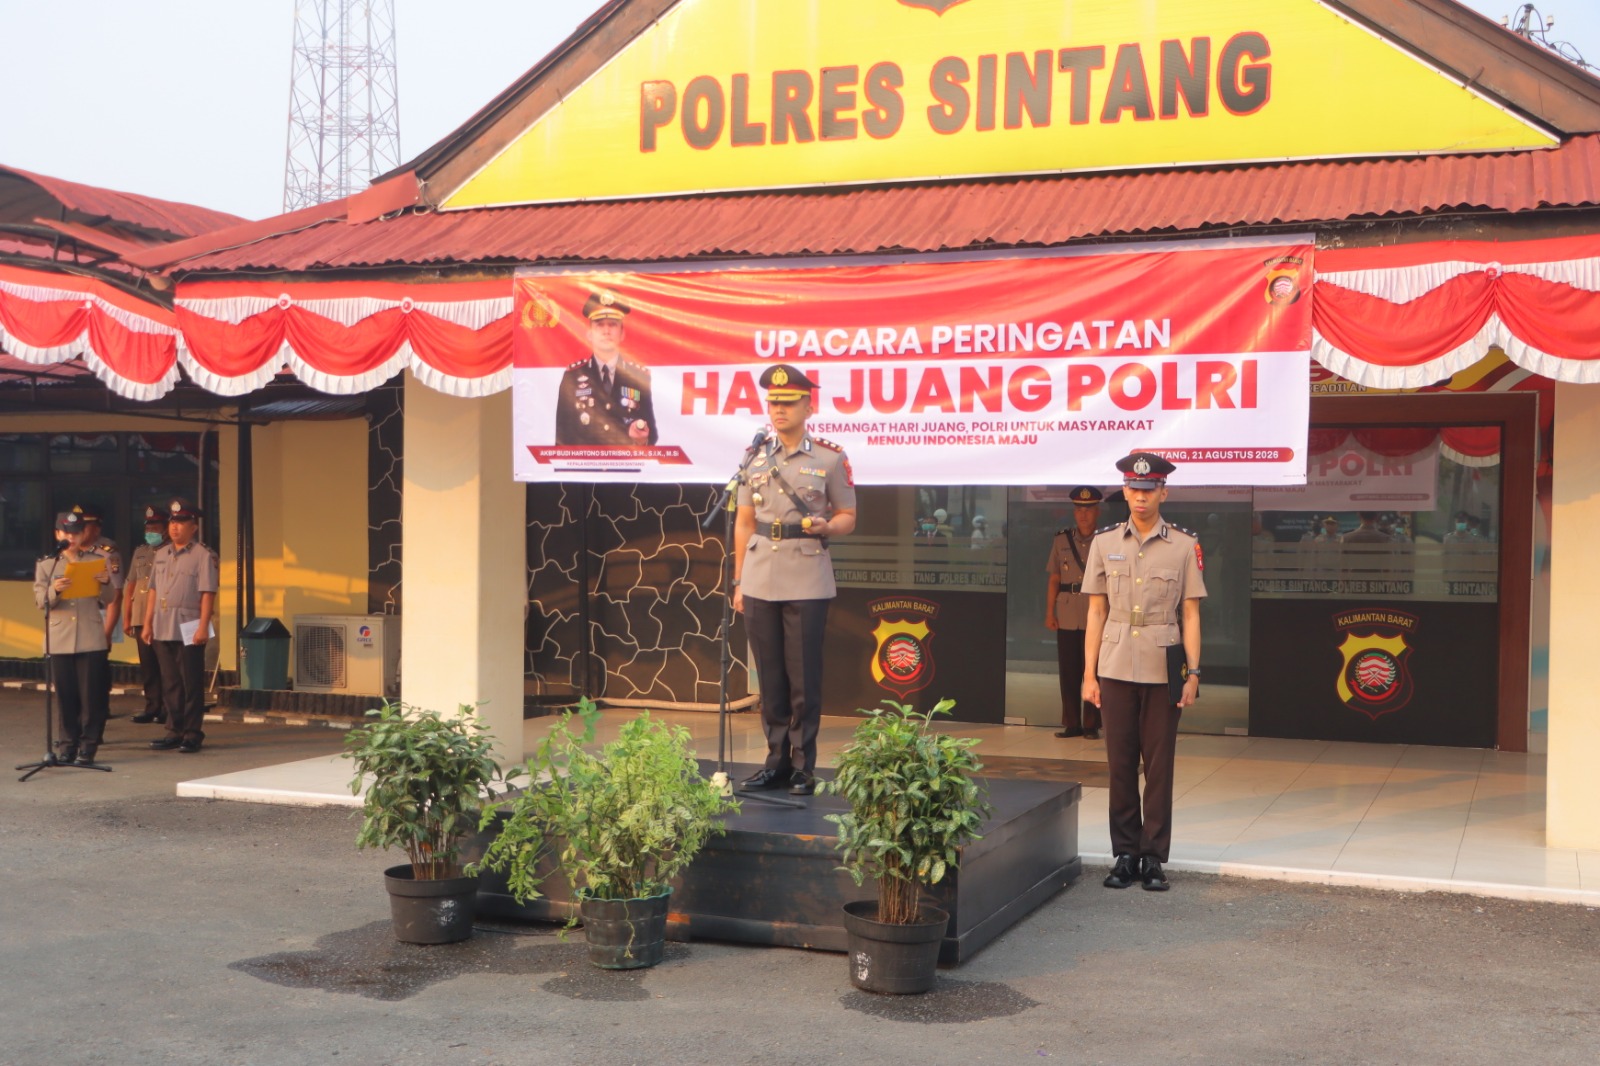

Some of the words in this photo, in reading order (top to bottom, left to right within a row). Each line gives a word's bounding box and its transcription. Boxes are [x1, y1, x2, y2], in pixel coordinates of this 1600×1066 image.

[640, 61, 903, 153] POLRES
[927, 31, 1271, 135] SINTANG
[754, 326, 923, 358] UPACARA
[931, 318, 1171, 354] PERINGATAN
[680, 369, 820, 416] HAI
[832, 364, 1051, 415] JUANG
[1067, 359, 1258, 412] POLRI
[1311, 382, 1368, 393] EADILAN
[818, 422, 887, 433] SEMANGAT
[889, 422, 919, 433] HARI
[922, 421, 968, 435] JUANG,
[972, 420, 1008, 432] POLRI
[1011, 420, 1055, 432] UNTUK
[1058, 419, 1155, 432] MASYARAKAT
[867, 434, 921, 446] MENUJU
[923, 434, 996, 446] INDONESIA
[998, 433, 1038, 445] MAJU
[1146, 451, 1189, 461] NTANG,
[1192, 451, 1203, 460] 21
[1205, 450, 1254, 460] AGUSTUS
[1255, 450, 1279, 459] 2026
[834, 570, 867, 581] SINTANG
[870, 571, 899, 582] POLRES
[939, 573, 969, 585] POLRES
[971, 573, 1006, 586] SINTANG
[1252, 578, 1286, 592] POLRES
[1288, 578, 1327, 592] SINTANG
[1332, 579, 1367, 593] POLRES
[1369, 580, 1410, 594] SINTANG
[1453, 582, 1495, 596] SINTANG
[872, 601, 912, 613] KALIMANTAN
[913, 602, 935, 614] BARAT
[1338, 612, 1386, 626] KALIMANTAN
[1387, 613, 1414, 628] BARAT
